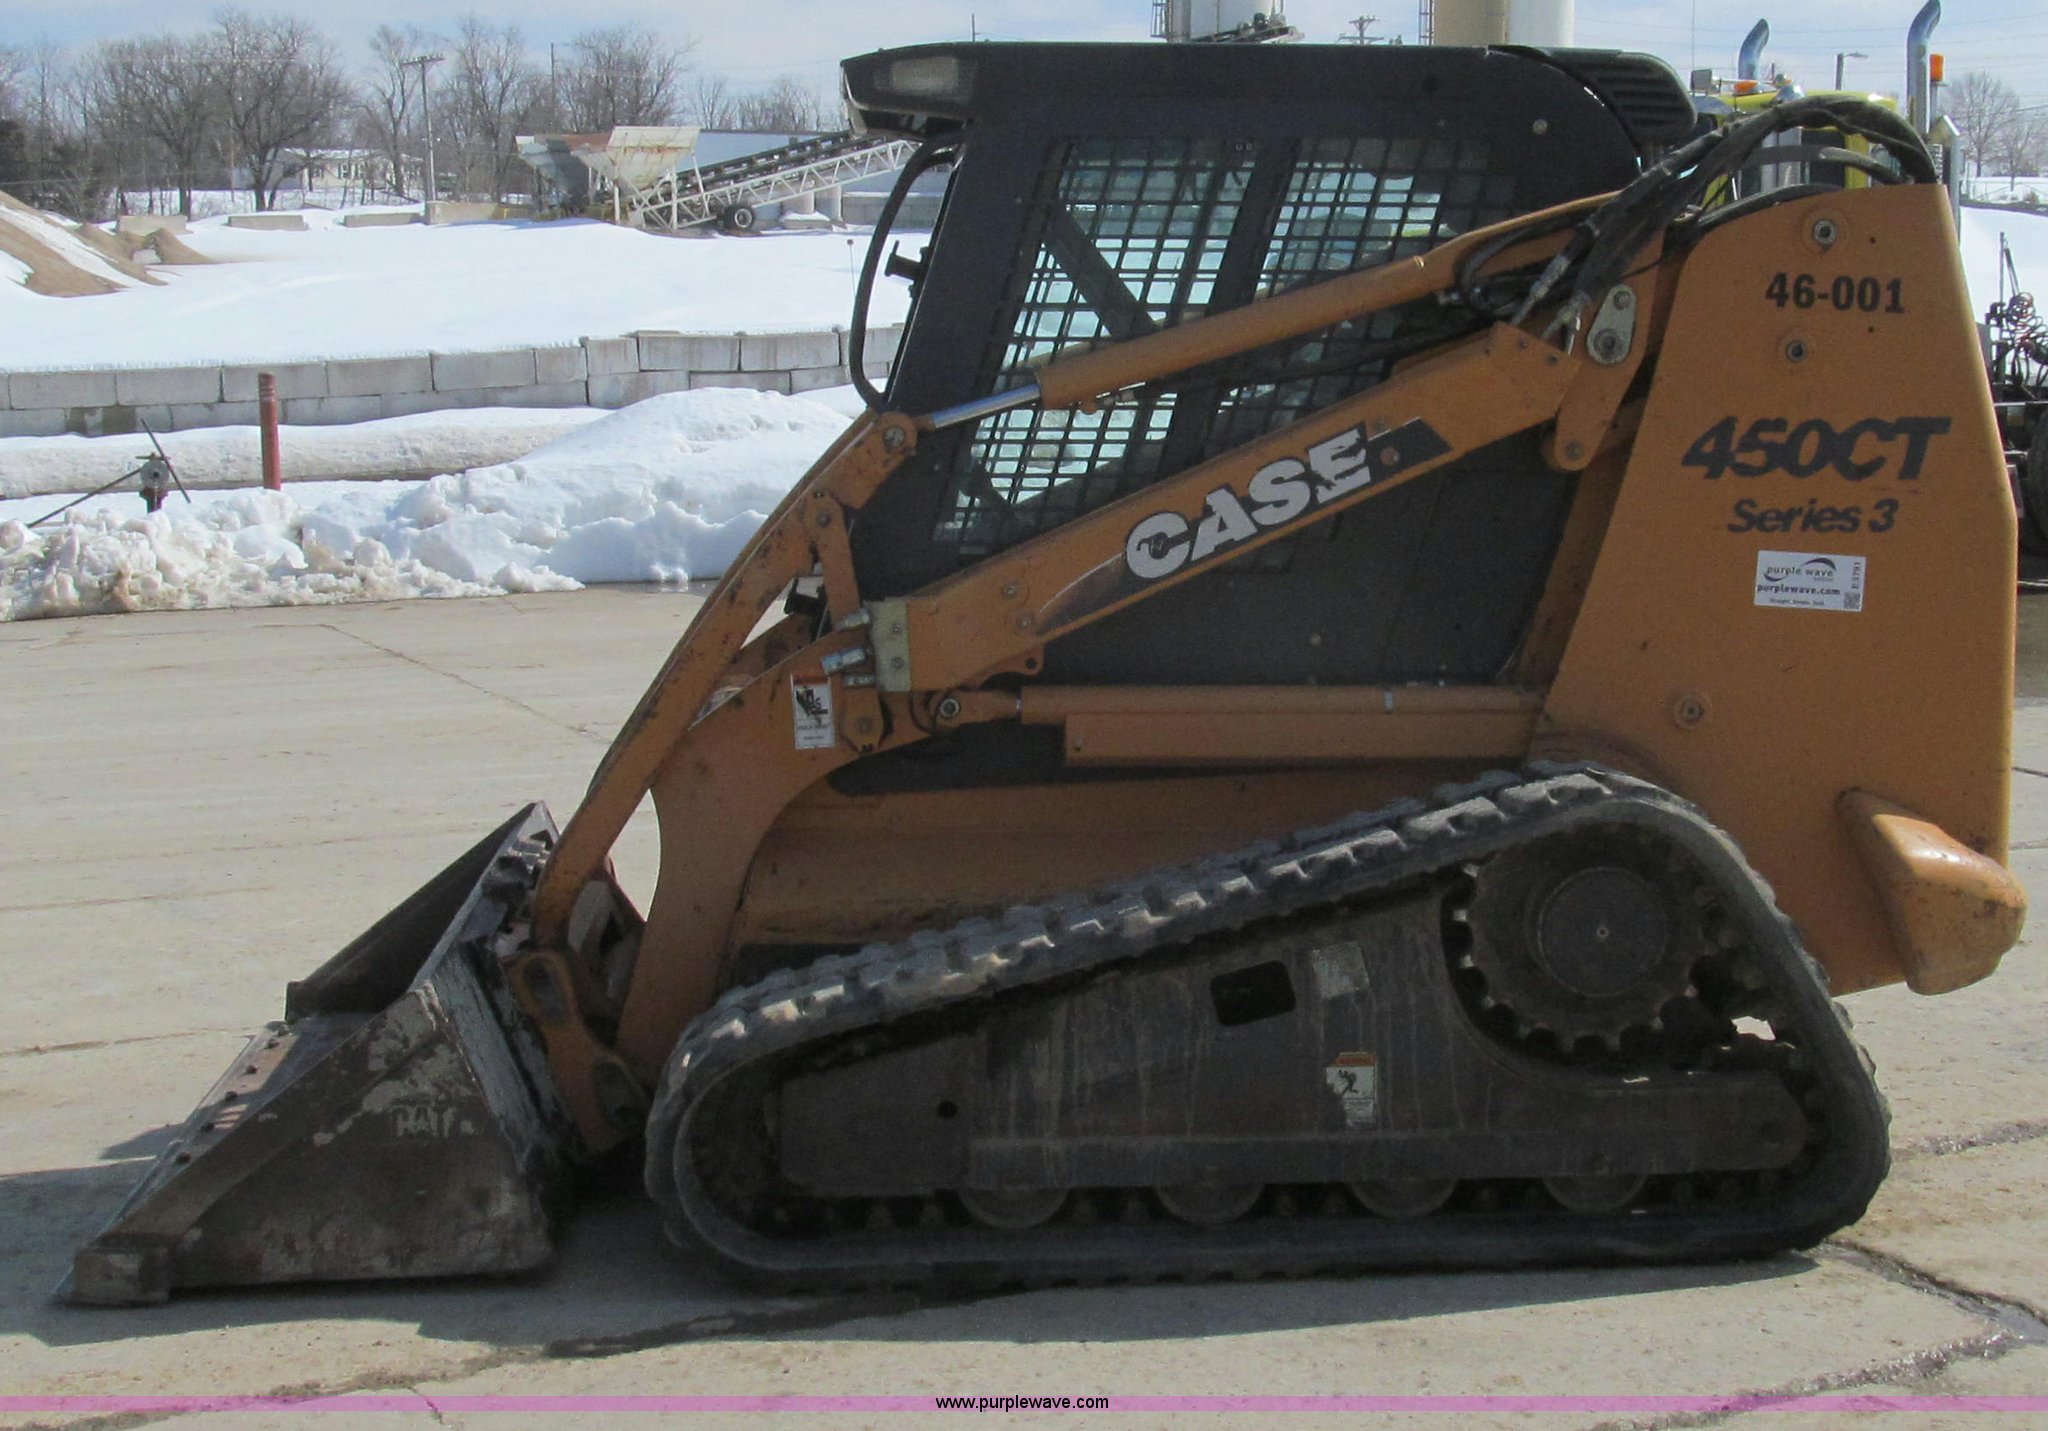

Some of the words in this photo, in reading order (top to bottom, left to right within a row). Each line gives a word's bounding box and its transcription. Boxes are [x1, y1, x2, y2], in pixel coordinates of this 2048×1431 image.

[1765, 271, 1905, 314] 46-001
[1681, 416, 1951, 481] 450CT
[1126, 428, 1372, 579] CASE
[1727, 497, 1862, 533] Series
[1869, 498, 1899, 533] 3
[1757, 583, 1841, 596] purplewave.com
[1766, 565, 1801, 575] purple
[1805, 568, 1833, 577] wave
